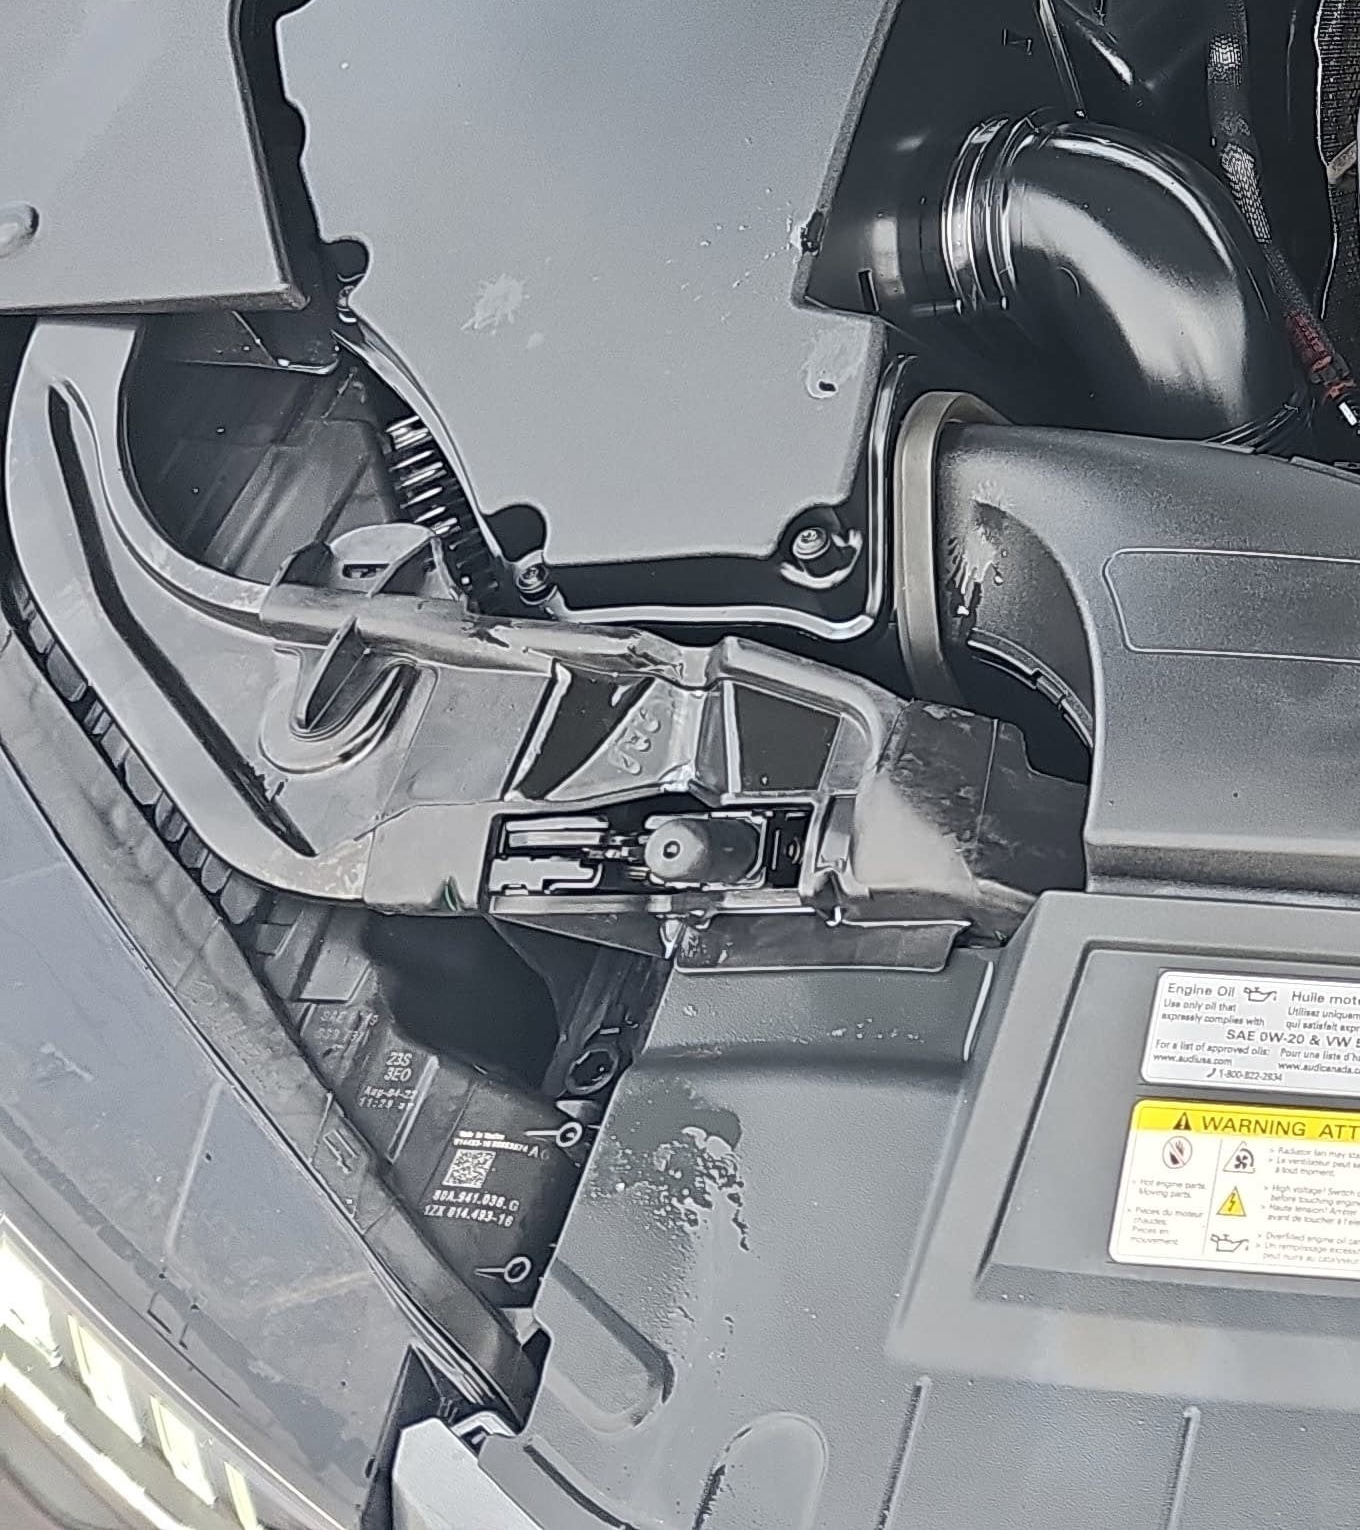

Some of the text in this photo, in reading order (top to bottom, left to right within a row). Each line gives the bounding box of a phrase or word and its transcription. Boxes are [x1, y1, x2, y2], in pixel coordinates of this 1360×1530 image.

[1168, 983, 1235, 997] Engine Oil
[1292, 991, 1325, 1003] Huile
[1163, 999, 1236, 1012] Use only oil that
[1161, 1013, 1265, 1026] expressly complies with
[1286, 1020, 1301, 1030] qui
[1226, 1029, 1256, 1041] SAE
[1260, 1032, 1305, 1044] 0W-20
[1309, 1034, 1320, 1046] &
[1326, 1035, 1352, 1047] VW
[1155, 1039, 1170, 1049] For
[1180, 1041, 1194, 1051] list
[1196, 1042, 1205, 1052] of
[1207, 1045, 1249, 1056] approved
[1280, 1048, 1301, 1058] Pour
[1304, 1051, 1320, 1059] une
[1322, 1050, 1341, 1060] liste
[385, 1051, 413, 1067] 23S
[1153, 1054, 1233, 1066] www.audiusa.com
[1202, 1115, 1306, 1137] WARNING
[1329, 1151, 1345, 1160] may
[1272, 1184, 1291, 1195] High
